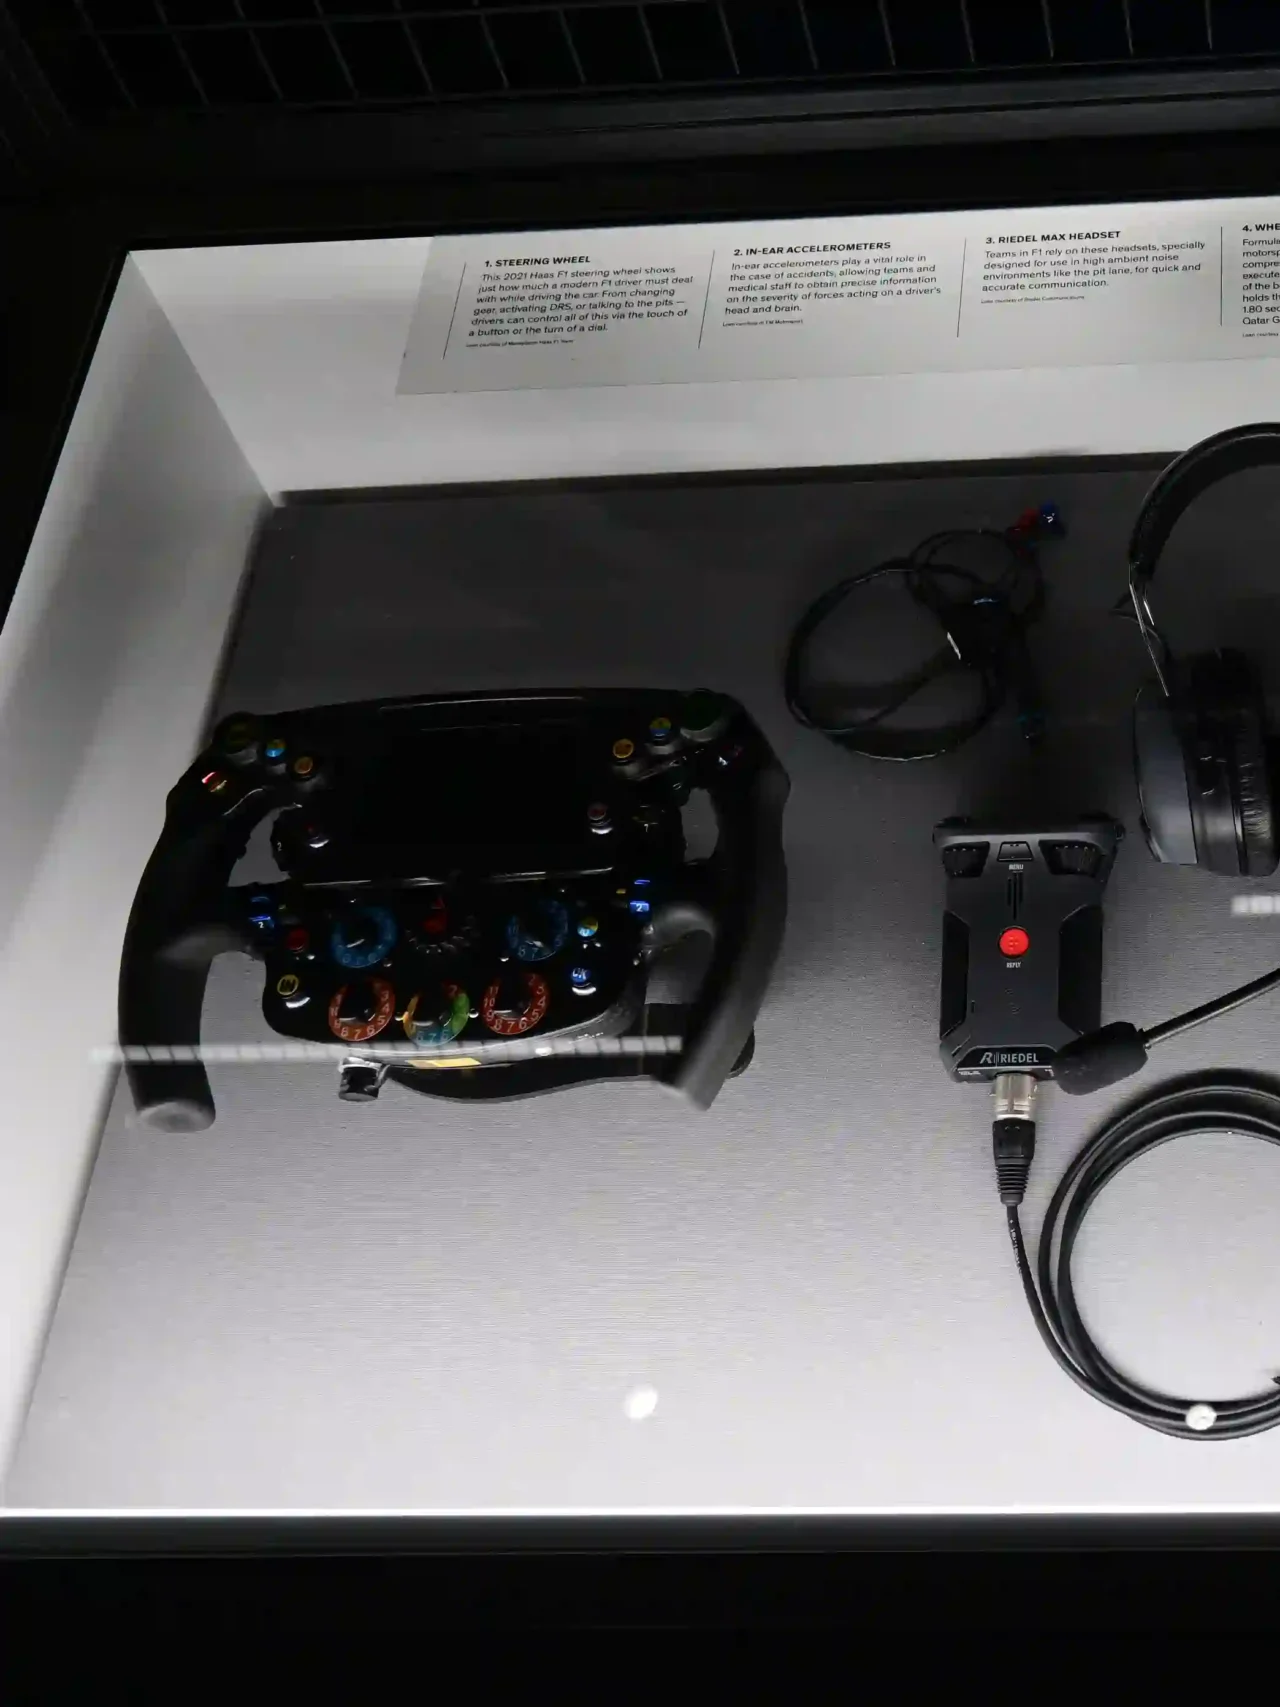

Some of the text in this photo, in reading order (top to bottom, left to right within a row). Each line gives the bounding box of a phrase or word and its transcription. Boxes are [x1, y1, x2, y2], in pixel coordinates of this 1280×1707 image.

[1242, 224, 1252, 232] 4.
[985, 230, 1120, 244] 3. RIEDEL MAX HEADSET
[1242, 236, 1280, 246] Formula
[733, 241, 891, 257] 2. IN-EAR ACCELEROMETERS
[985, 249, 1016, 258] Teams
[1019, 248, 1028, 257] in
[1031, 248, 1041, 256] F1
[1045, 247, 1062, 258] rely
[1081, 245, 1108, 254] these
[1111, 243, 1159, 255] headsets,
[1161, 241, 1205, 253] specially
[483, 255, 591, 269] 1. STEERING WHEEL
[731, 260, 760, 269] In-ear
[762, 257, 839, 268] accelerometers
[841, 256, 861, 267] play
[872, 255, 892, 264] vital
[895, 254, 914, 263] role
[917, 254, 926, 262] in
[983, 258, 1030, 270] designed
[1033, 258, 1047, 266] for
[1070, 256, 1079, 265] in
[1082, 255, 1104, 266] high
[1107, 253, 1148, 263] ambient
[1151, 252, 1178, 261] noise
[481, 265, 676, 281] This 2021 Haas F1 steering wheel shows
[730, 272, 746, 281] the
[774, 270, 784, 279] of
[786, 268, 837, 280] accidents,
[838, 266, 881, 278] allowing
[883, 265, 914, 274] teams
[916, 264, 935, 273] and
[982, 278, 1108, 291] accurate communication.
[1242, 281, 1252, 290] of
[1254, 281, 1270, 289] the
[724, 303, 802, 314] head and brain.
[1242, 315, 1269, 324] Qatar
[477, 327, 510, 336] button
[524, 325, 542, 334] the
[543, 324, 564, 333] turn
[566, 324, 577, 332] of
[587, 322, 608, 331] dial.
[1000, 1052, 1039, 1064] RIEDEL
